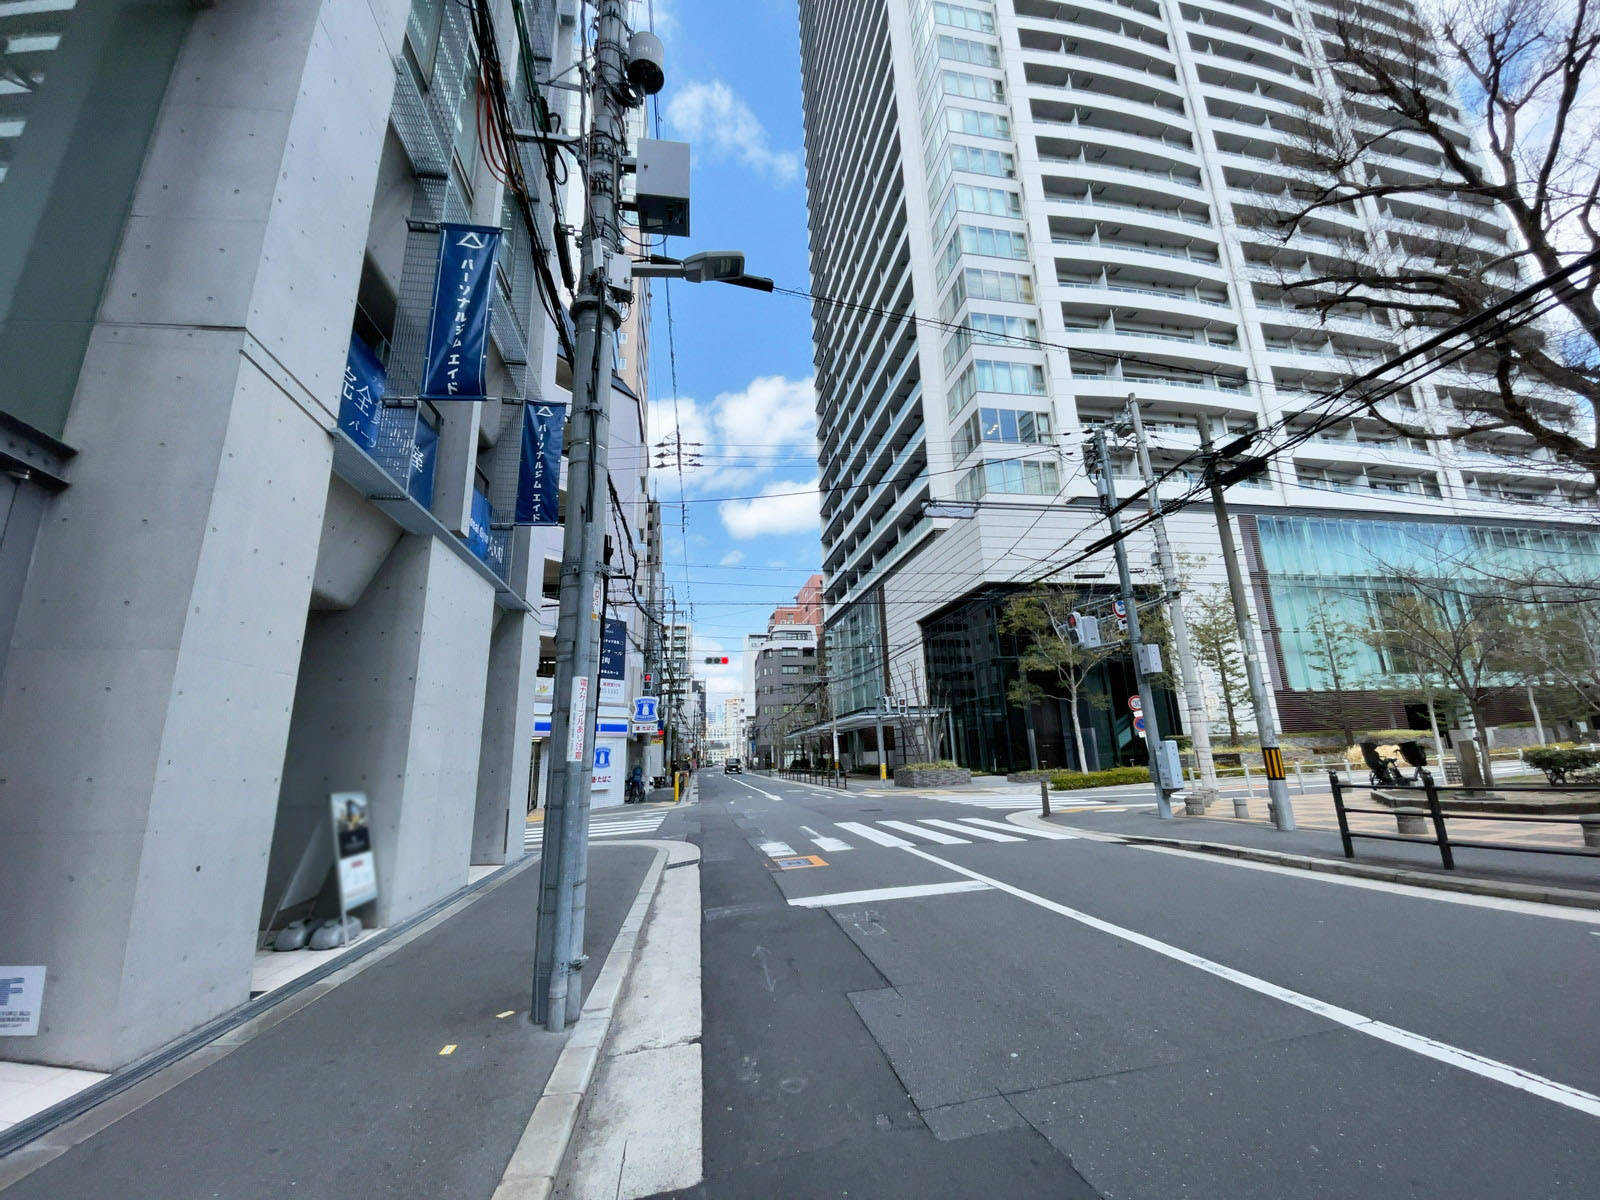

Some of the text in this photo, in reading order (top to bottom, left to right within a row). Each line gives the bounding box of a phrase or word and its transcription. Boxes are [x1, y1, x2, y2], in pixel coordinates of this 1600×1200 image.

[447, 258, 474, 396] パーソナルジム エイド
[532, 423, 547, 522] パーソナルジム エイド
